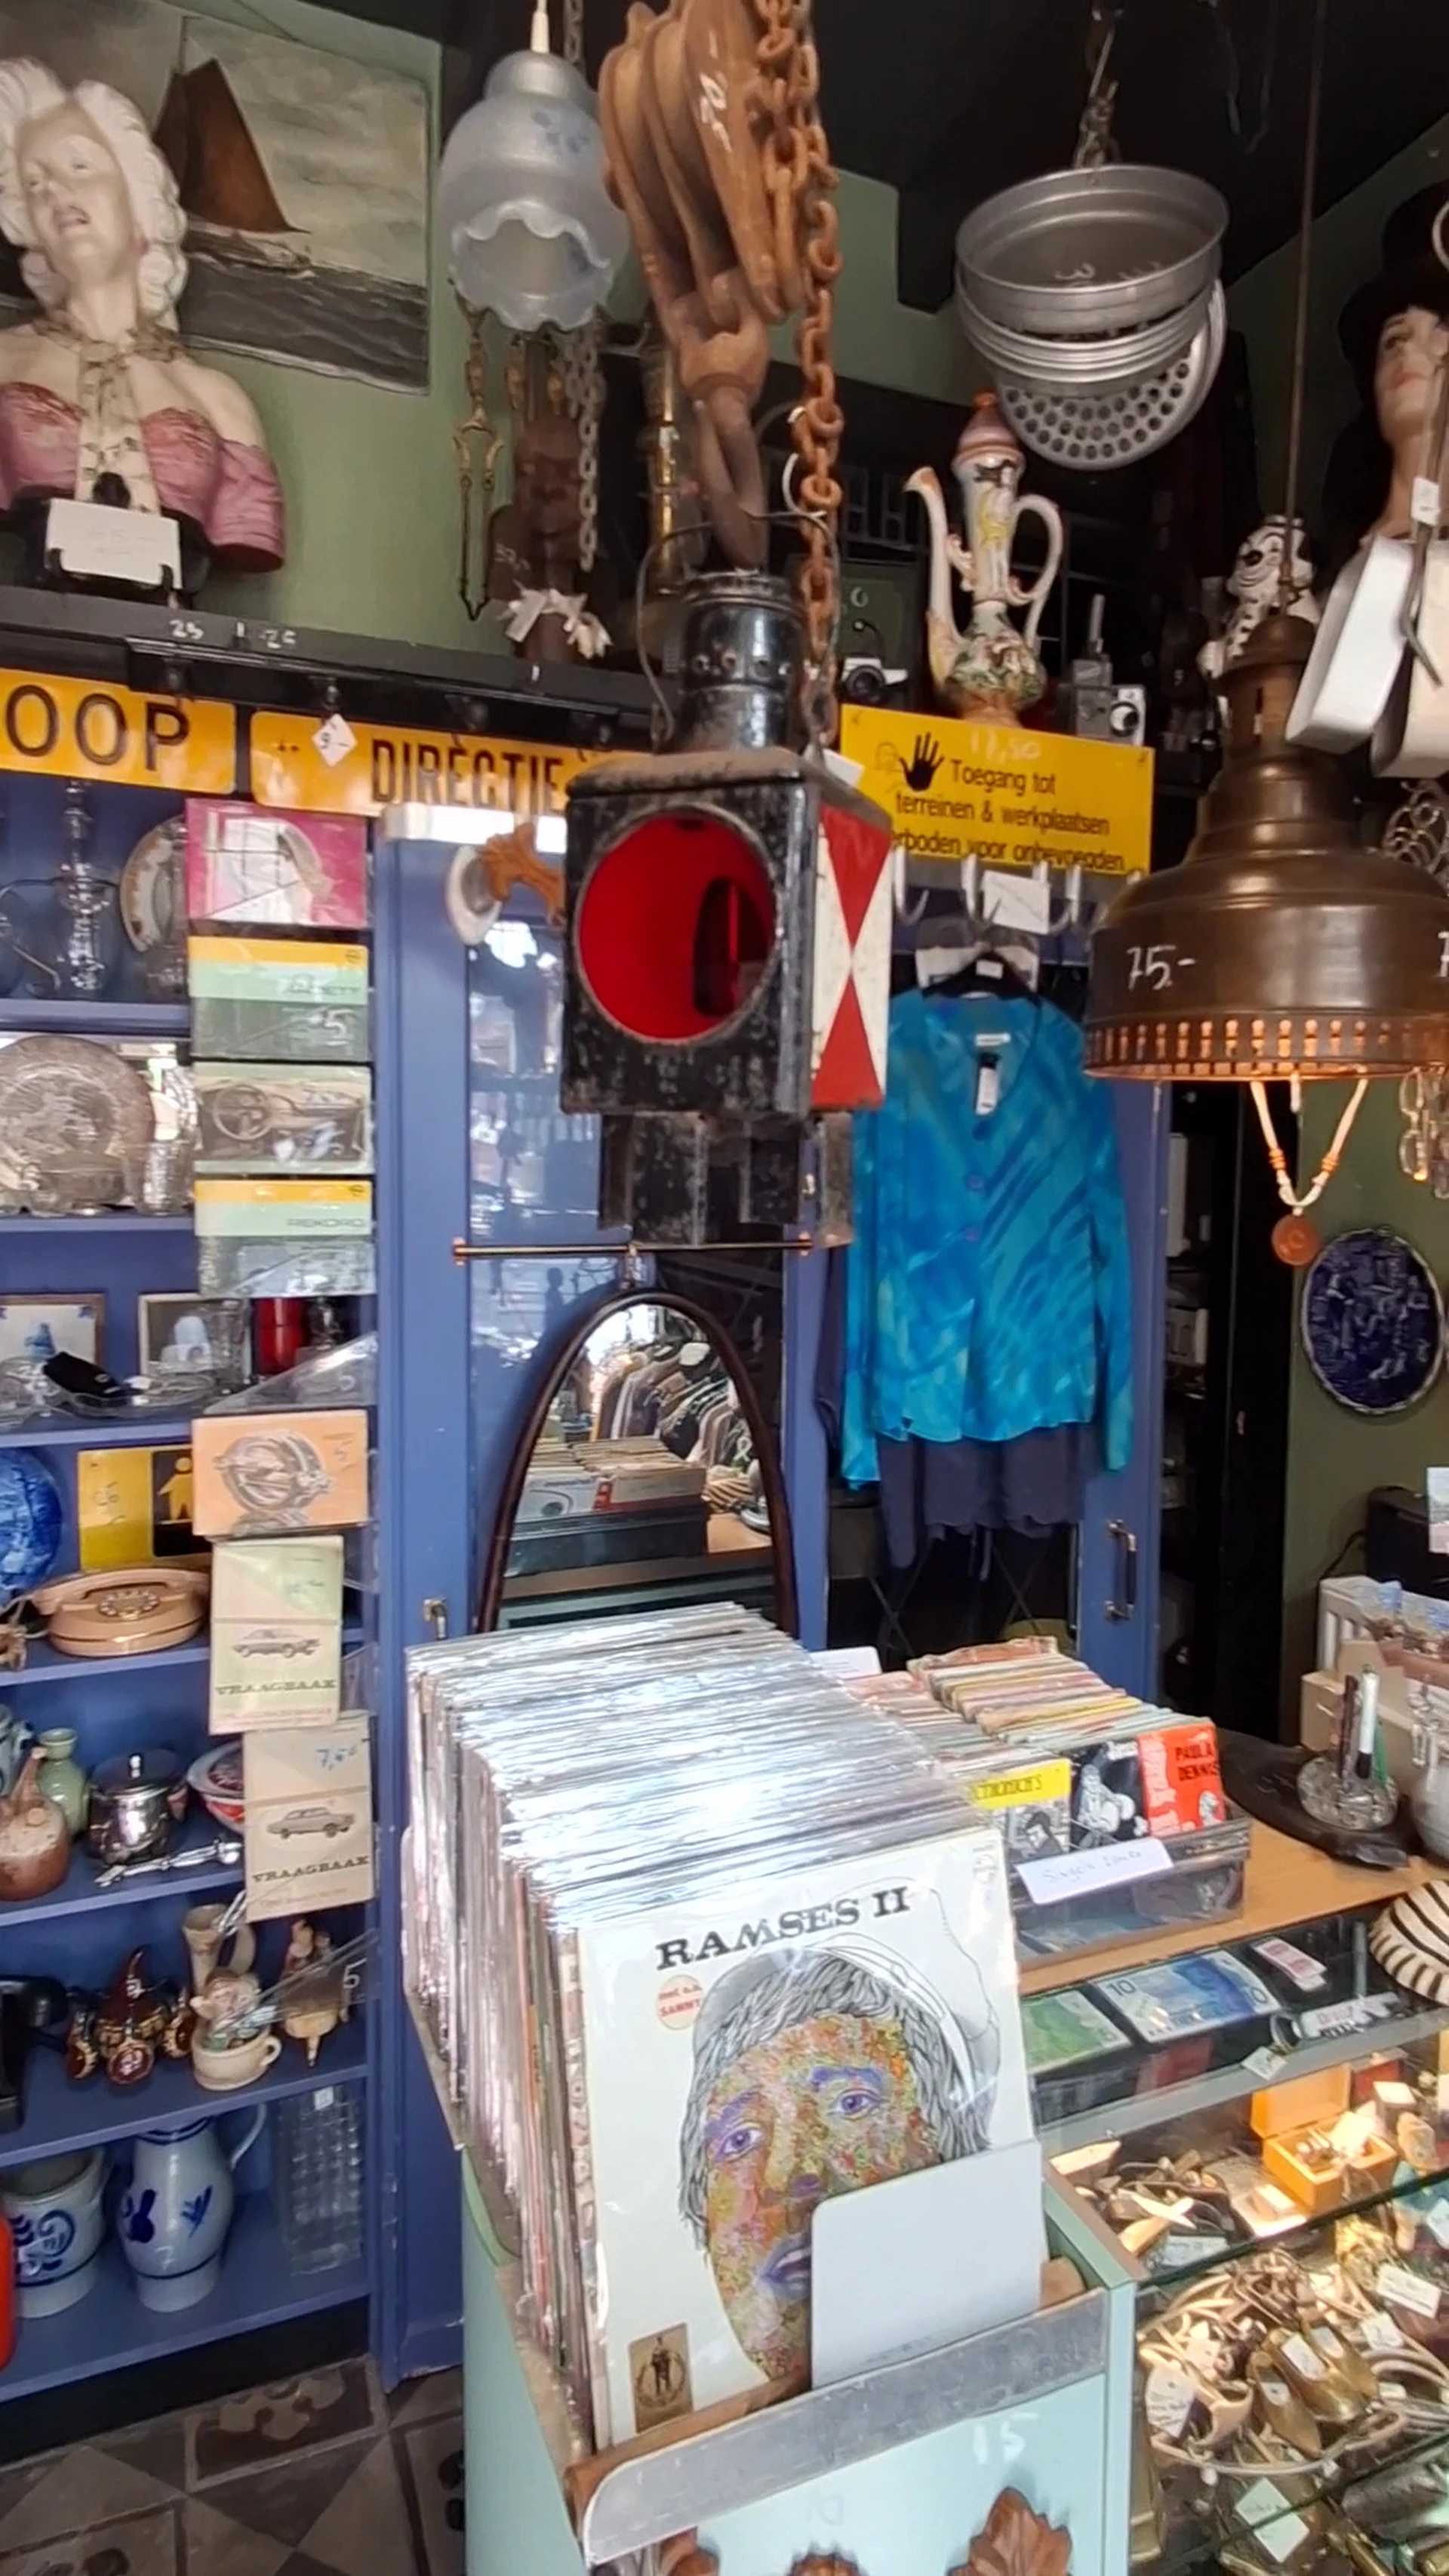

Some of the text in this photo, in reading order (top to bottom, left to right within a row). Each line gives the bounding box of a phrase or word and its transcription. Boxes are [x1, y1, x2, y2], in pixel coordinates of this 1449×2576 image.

[6, 684, 190, 771] OOP
[372, 738, 566, 814] DIRECTIE
[950, 759, 1057, 796] Toegang tot
[896, 792, 1109, 837] terreinen & werkplaatsen
[252, 1854, 369, 1884] VRAAGBAAK
[655, 1885, 911, 1971] RAMSES II
[1106, 1978, 1137, 1997] 10
